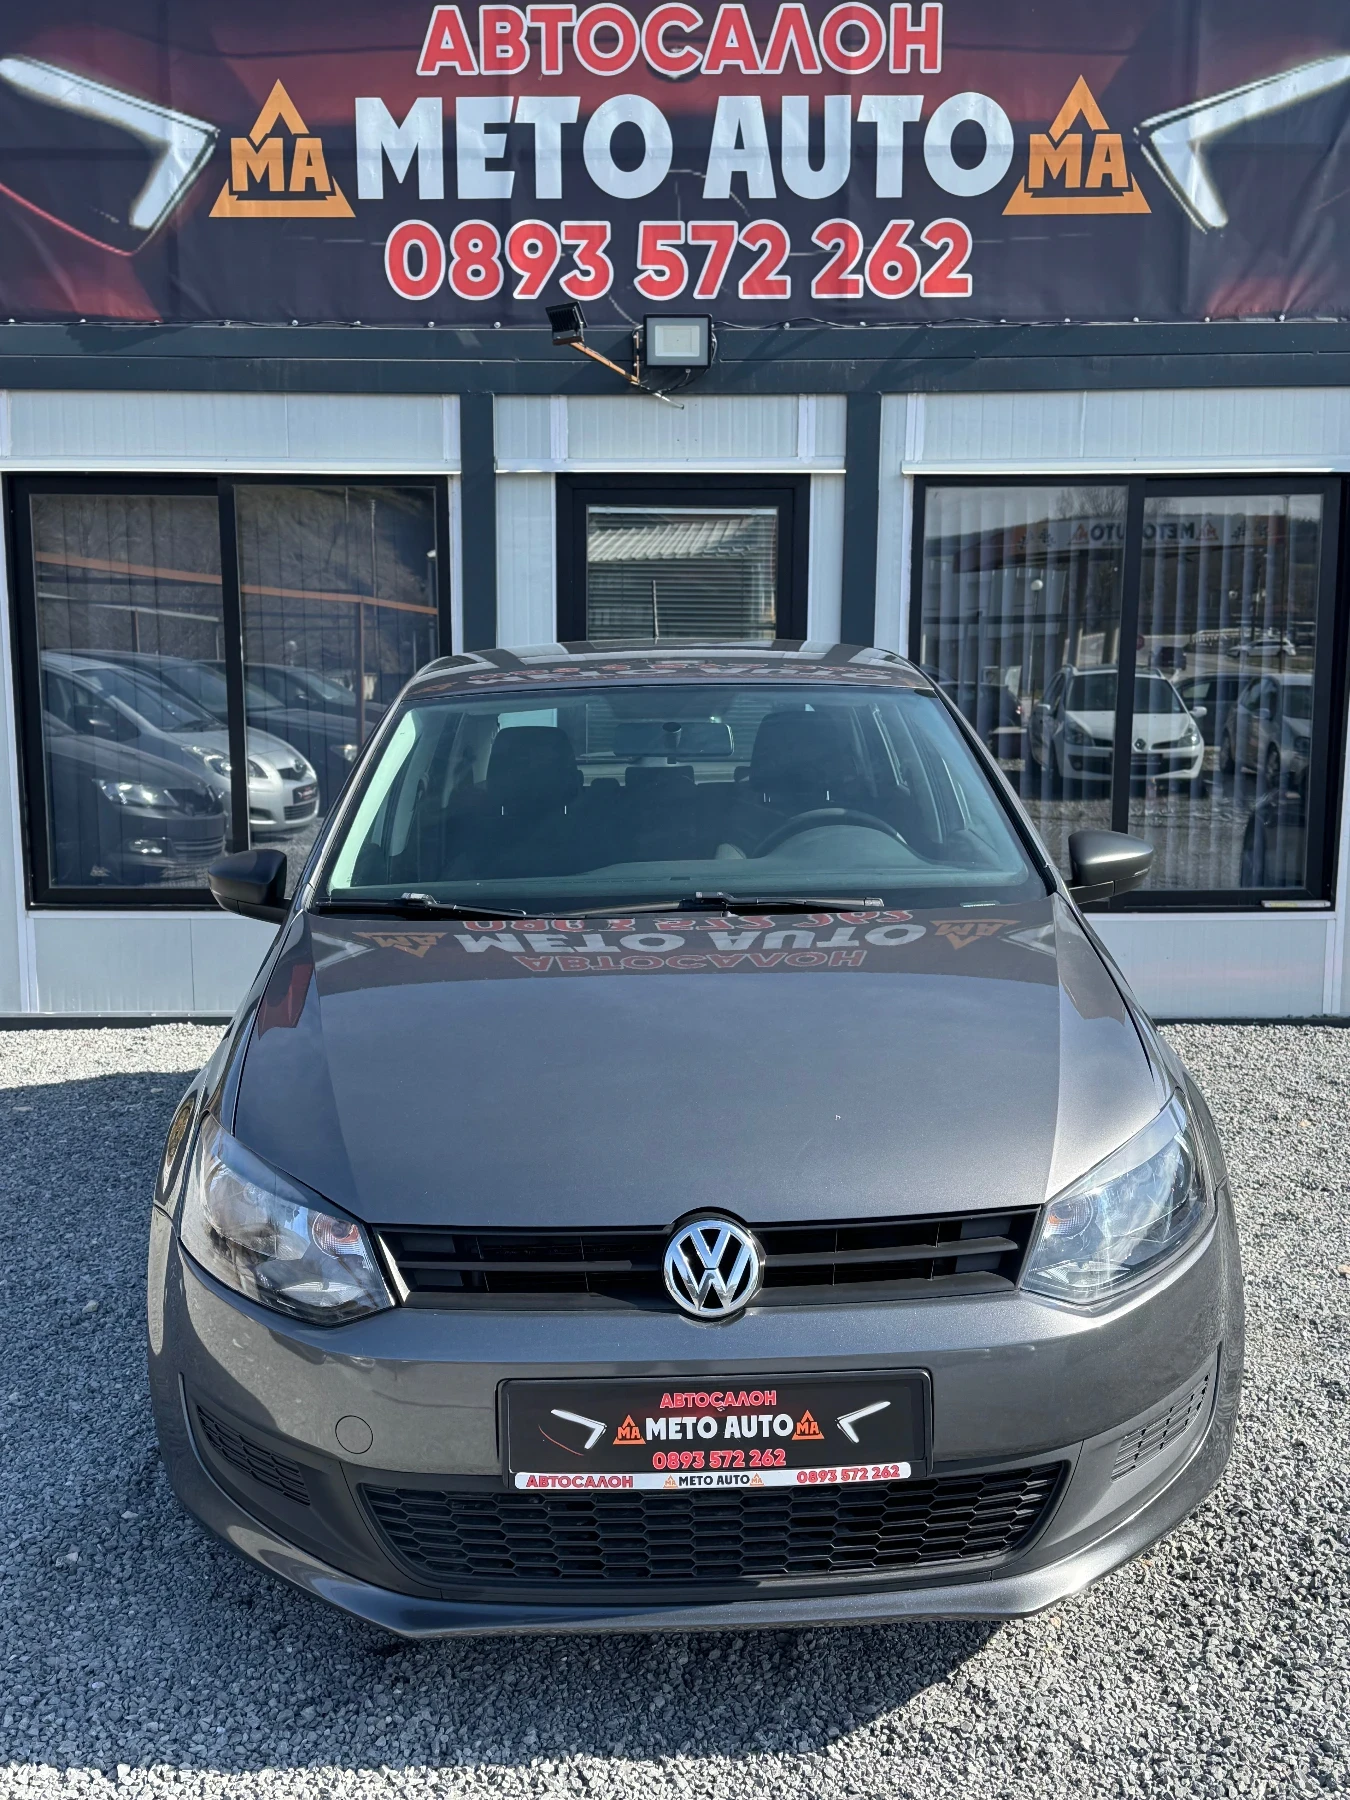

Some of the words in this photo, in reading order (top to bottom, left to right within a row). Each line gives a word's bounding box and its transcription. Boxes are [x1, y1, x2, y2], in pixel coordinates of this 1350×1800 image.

[416, 2, 943, 77] АВТОСАЛОН
[229, 136, 332, 193] MA
[355, 94, 673, 200] METO
[702, 91, 1015, 199] AUTO
[1027, 133, 1129, 189] MA
[385, 219, 614, 301] 0893
[637, 218, 791, 300] 572
[811, 217, 973, 299] 262
[659, 1390, 777, 1409] АВТОСАЛОН
[617, 1425, 641, 1440] MA
[645, 1416, 718, 1441] METO
[723, 1413, 794, 1439] AUTO
[796, 1420, 820, 1436] MA
[652, 1451, 705, 1470] 0893
[709, 1449, 745, 1468] 572
[749, 1448, 786, 1467] 262
[526, 1474, 634, 1488] АВТОСАЛОН
[678, 1475, 713, 1487] METO
[716, 1474, 750, 1486] AUTO
[796, 1469, 838, 1485] 0893
[841, 1467, 869, 1482] 572
[871, 1464, 900, 1479] 262
